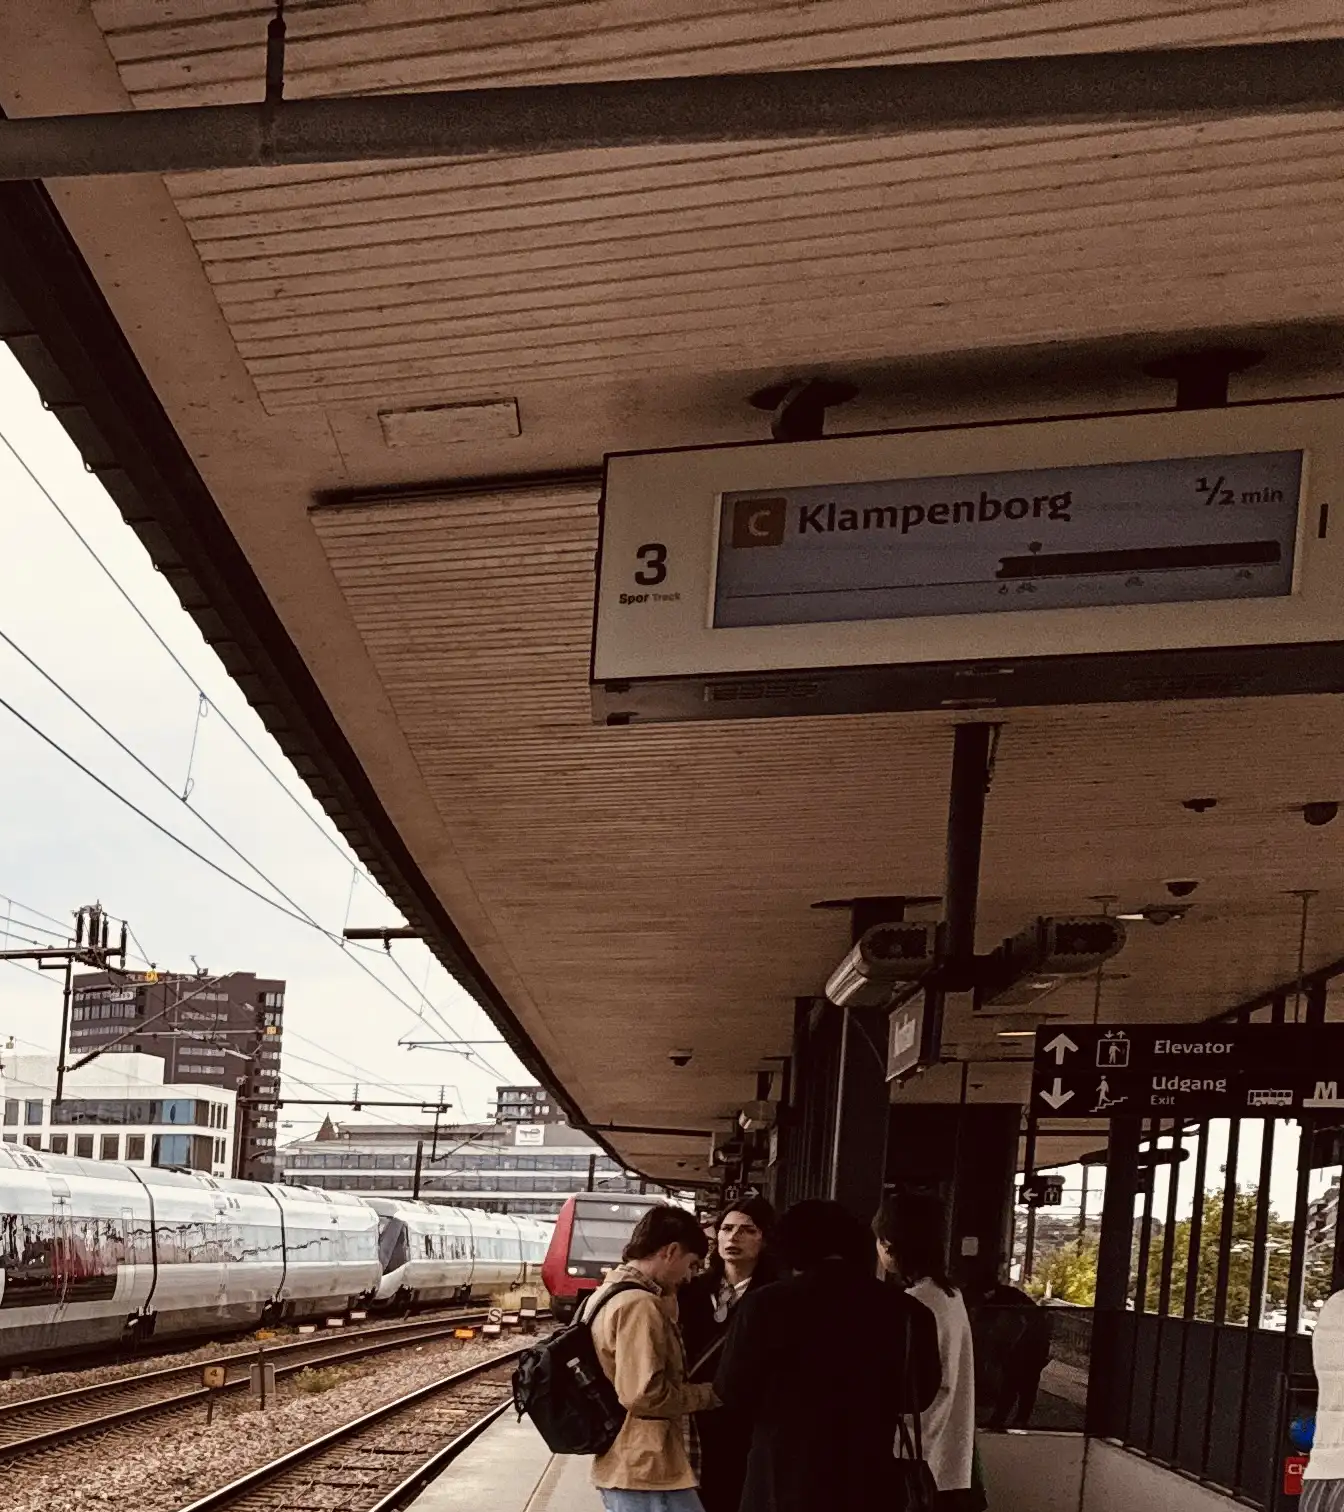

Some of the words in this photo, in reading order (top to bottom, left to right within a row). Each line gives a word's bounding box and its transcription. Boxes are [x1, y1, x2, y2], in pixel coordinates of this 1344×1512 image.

[749, 510, 771, 536] C
[798, 491, 1073, 534] Klampenborg
[1241, 487, 1284, 503] min
[635, 543, 667, 585] 3
[619, 593, 650, 605] Spor
[652, 592, 681, 602] Track
[1154, 1039, 1234, 1055] Elevator
[1152, 1076, 1227, 1093] Udgang
[1150, 1095, 1176, 1106] Exit
[489, 1308, 501, 1324] S
